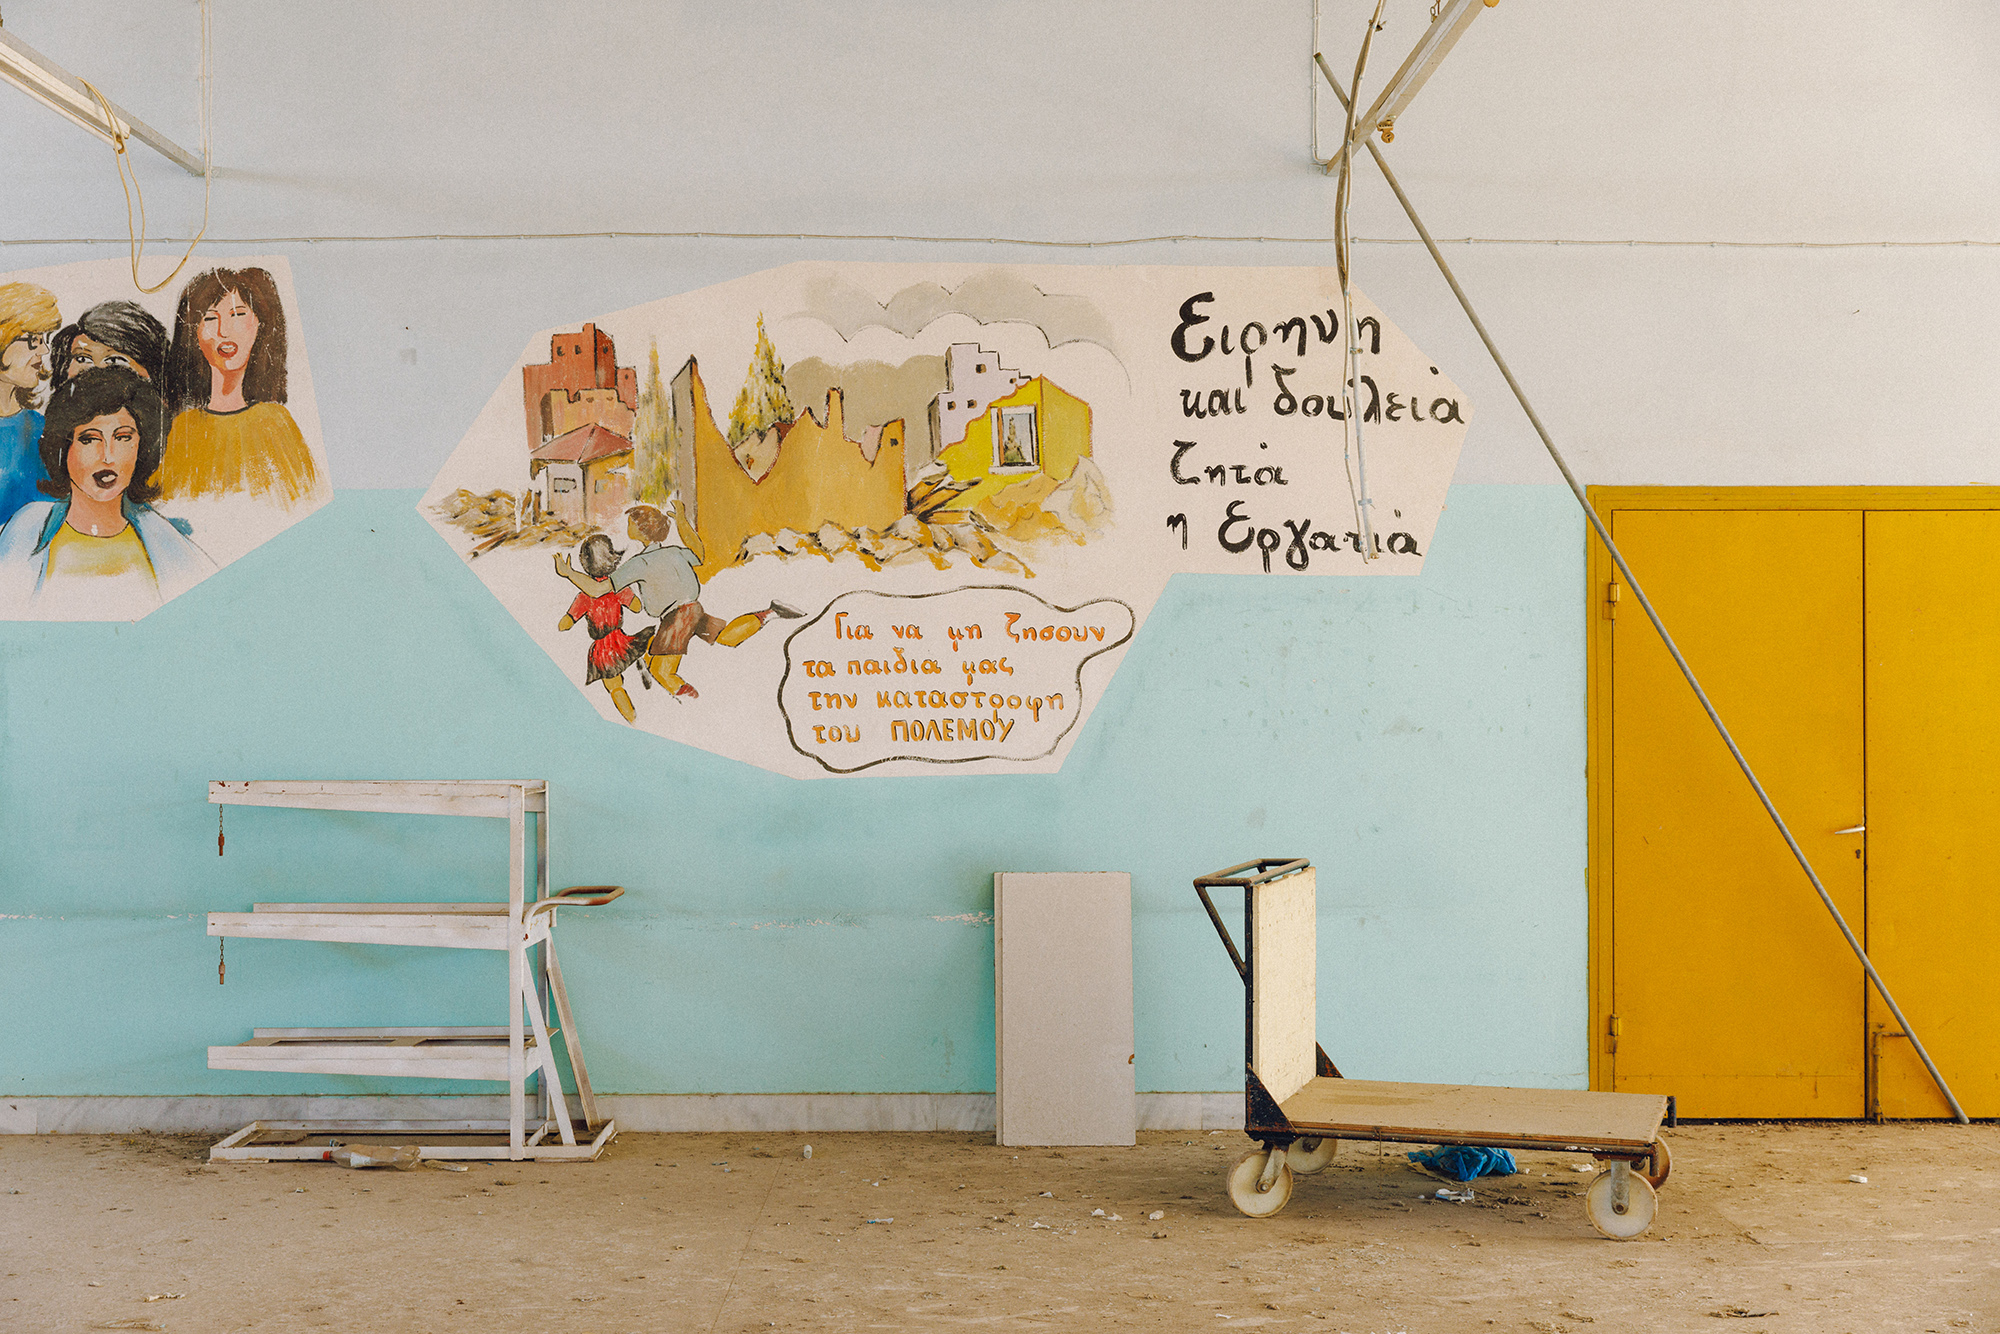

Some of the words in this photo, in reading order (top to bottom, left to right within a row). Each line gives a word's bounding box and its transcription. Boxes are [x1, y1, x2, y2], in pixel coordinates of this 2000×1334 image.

[1171, 291, 1381, 388] Ειρηνη
[1180, 386, 1246, 419] και
[1166, 512, 1188, 550] η
[835, 612, 874, 640] Για
[892, 624, 923, 639] να
[948, 624, 982, 651] μη
[1005, 611, 1106, 642] ζησουν
[802, 659, 836, 678] τα
[847, 646, 942, 675] παιδια
[962, 658, 1014, 686] μας
[808, 690, 858, 710] την
[877, 690, 1064, 723] καταστροφη
[812, 723, 861, 744] του
[891, 718, 1015, 743] ΠΟΛΕΜΟΥ
